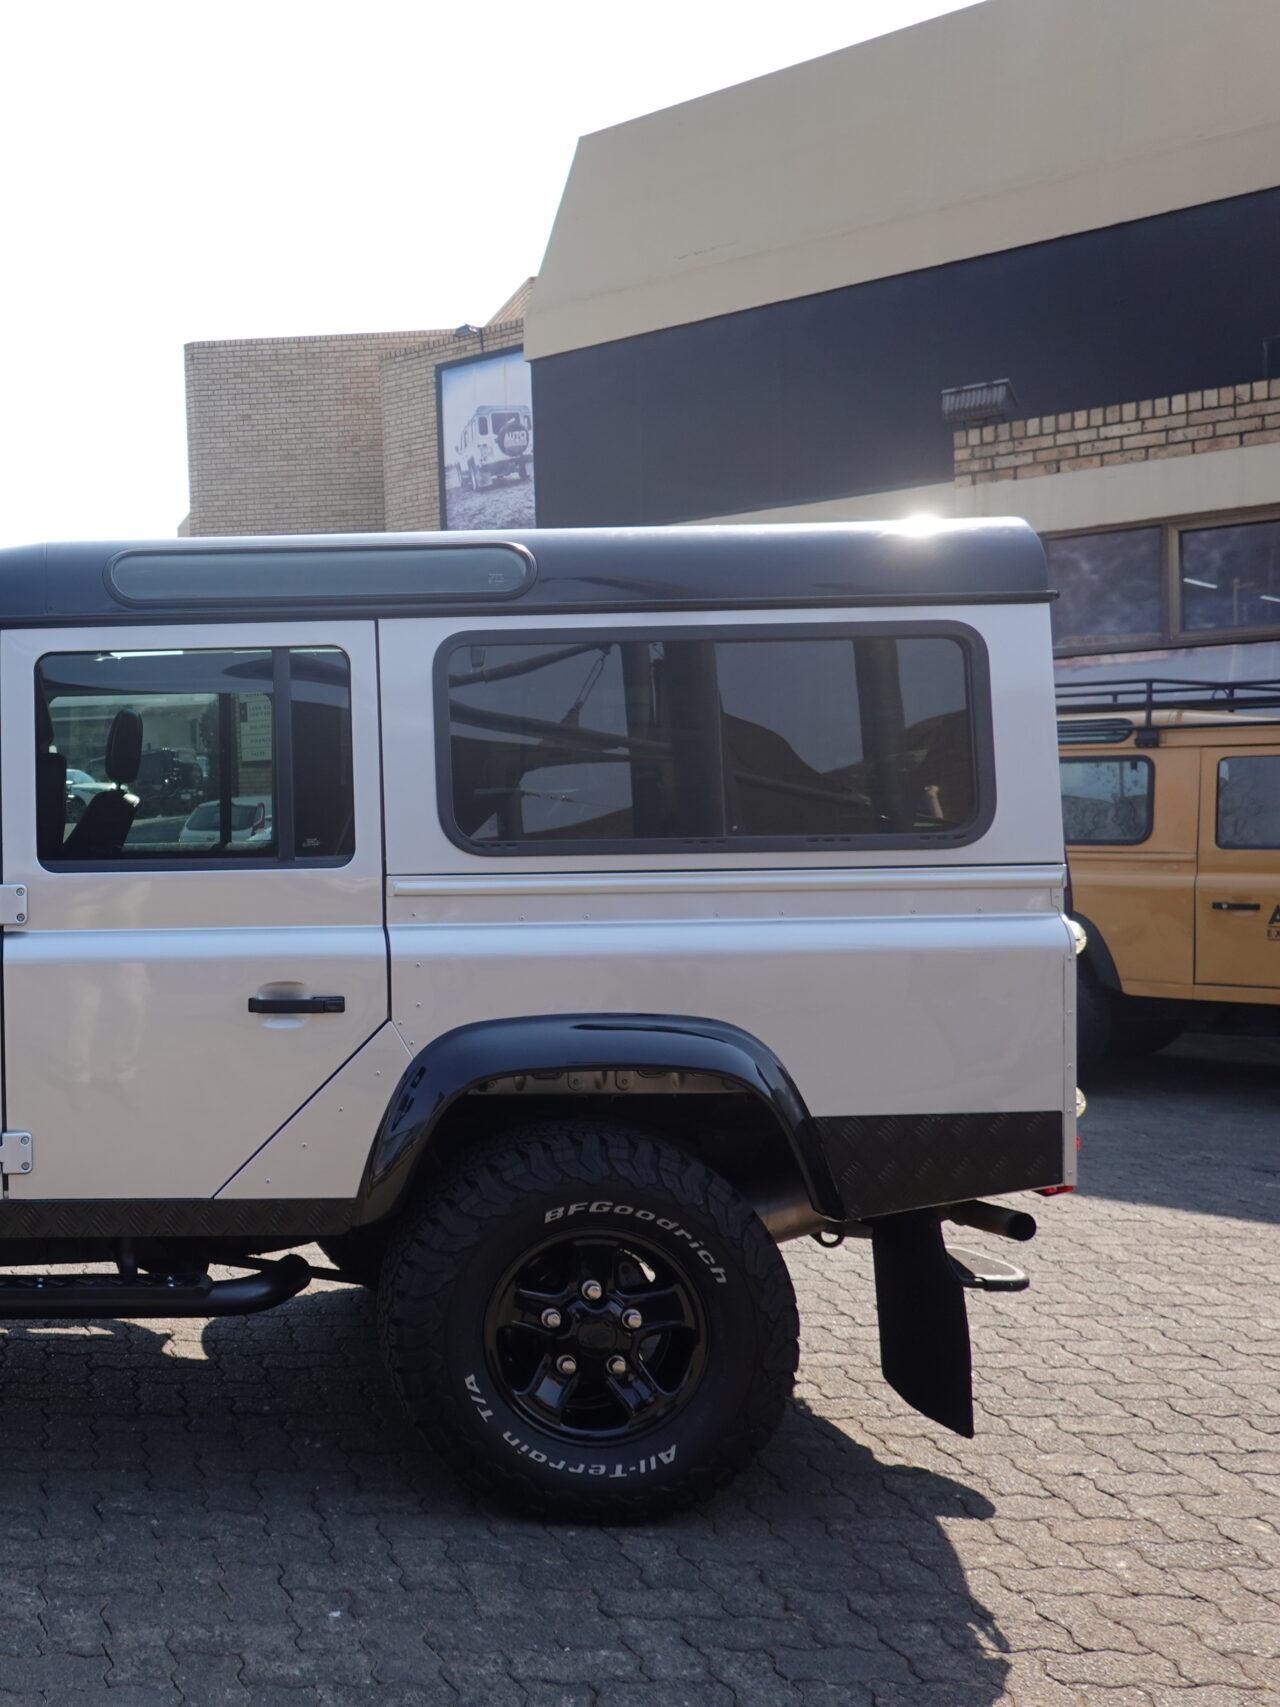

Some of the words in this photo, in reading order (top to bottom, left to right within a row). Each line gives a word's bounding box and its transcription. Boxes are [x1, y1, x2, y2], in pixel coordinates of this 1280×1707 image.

[544, 1201, 727, 1284] BFGoodrich
[464, 1373, 494, 1423] T/A
[502, 1431, 677, 1478] All-Terrain
